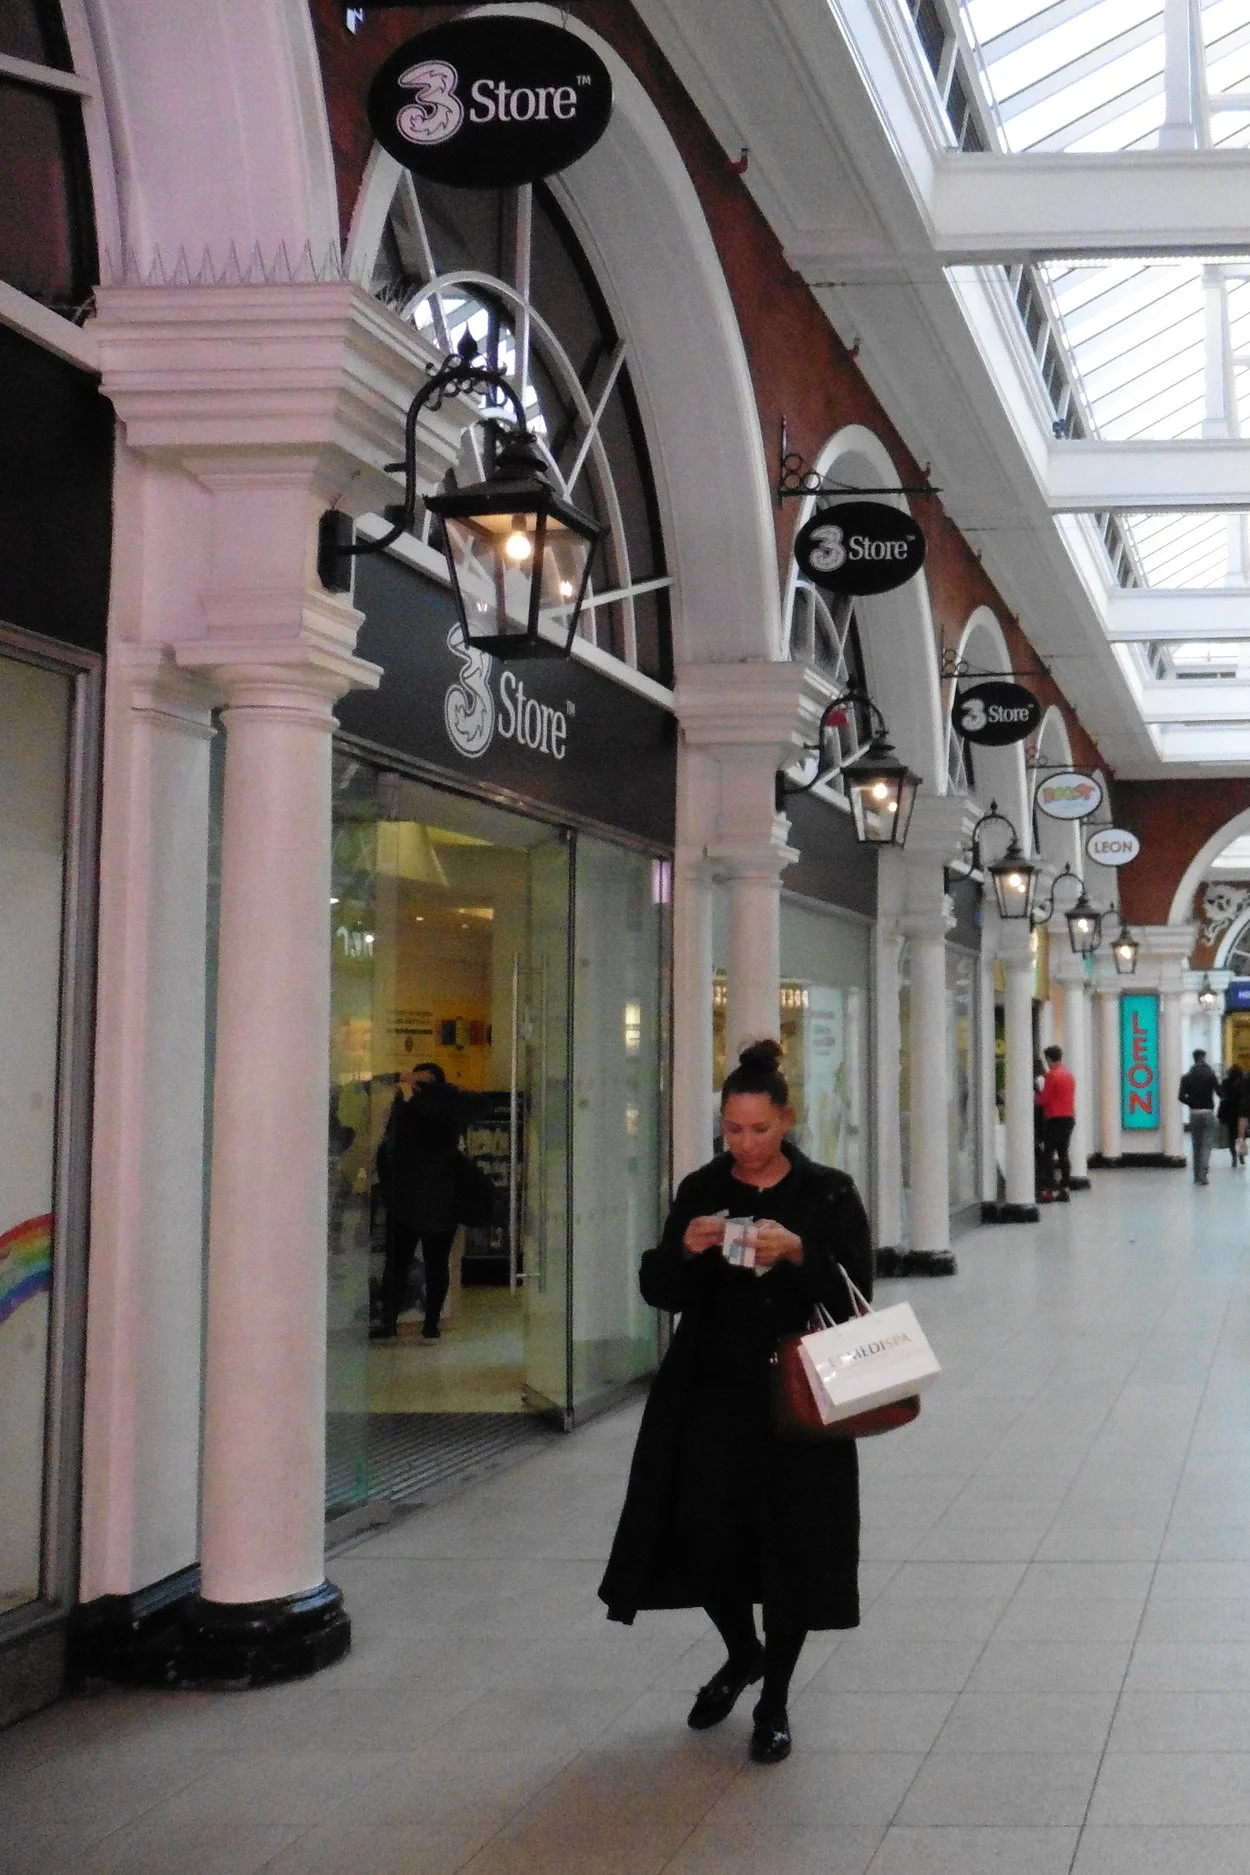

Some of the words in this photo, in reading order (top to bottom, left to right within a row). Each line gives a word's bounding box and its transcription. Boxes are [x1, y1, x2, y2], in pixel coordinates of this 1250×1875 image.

[469, 78, 577, 123] Store
[848, 535, 908, 560] Store
[498, 671, 567, 760] Store
[988, 705, 1029, 723] Store
[1094, 841, 1133, 853] LEON
[1128, 1010, 1153, 1114] LEON
